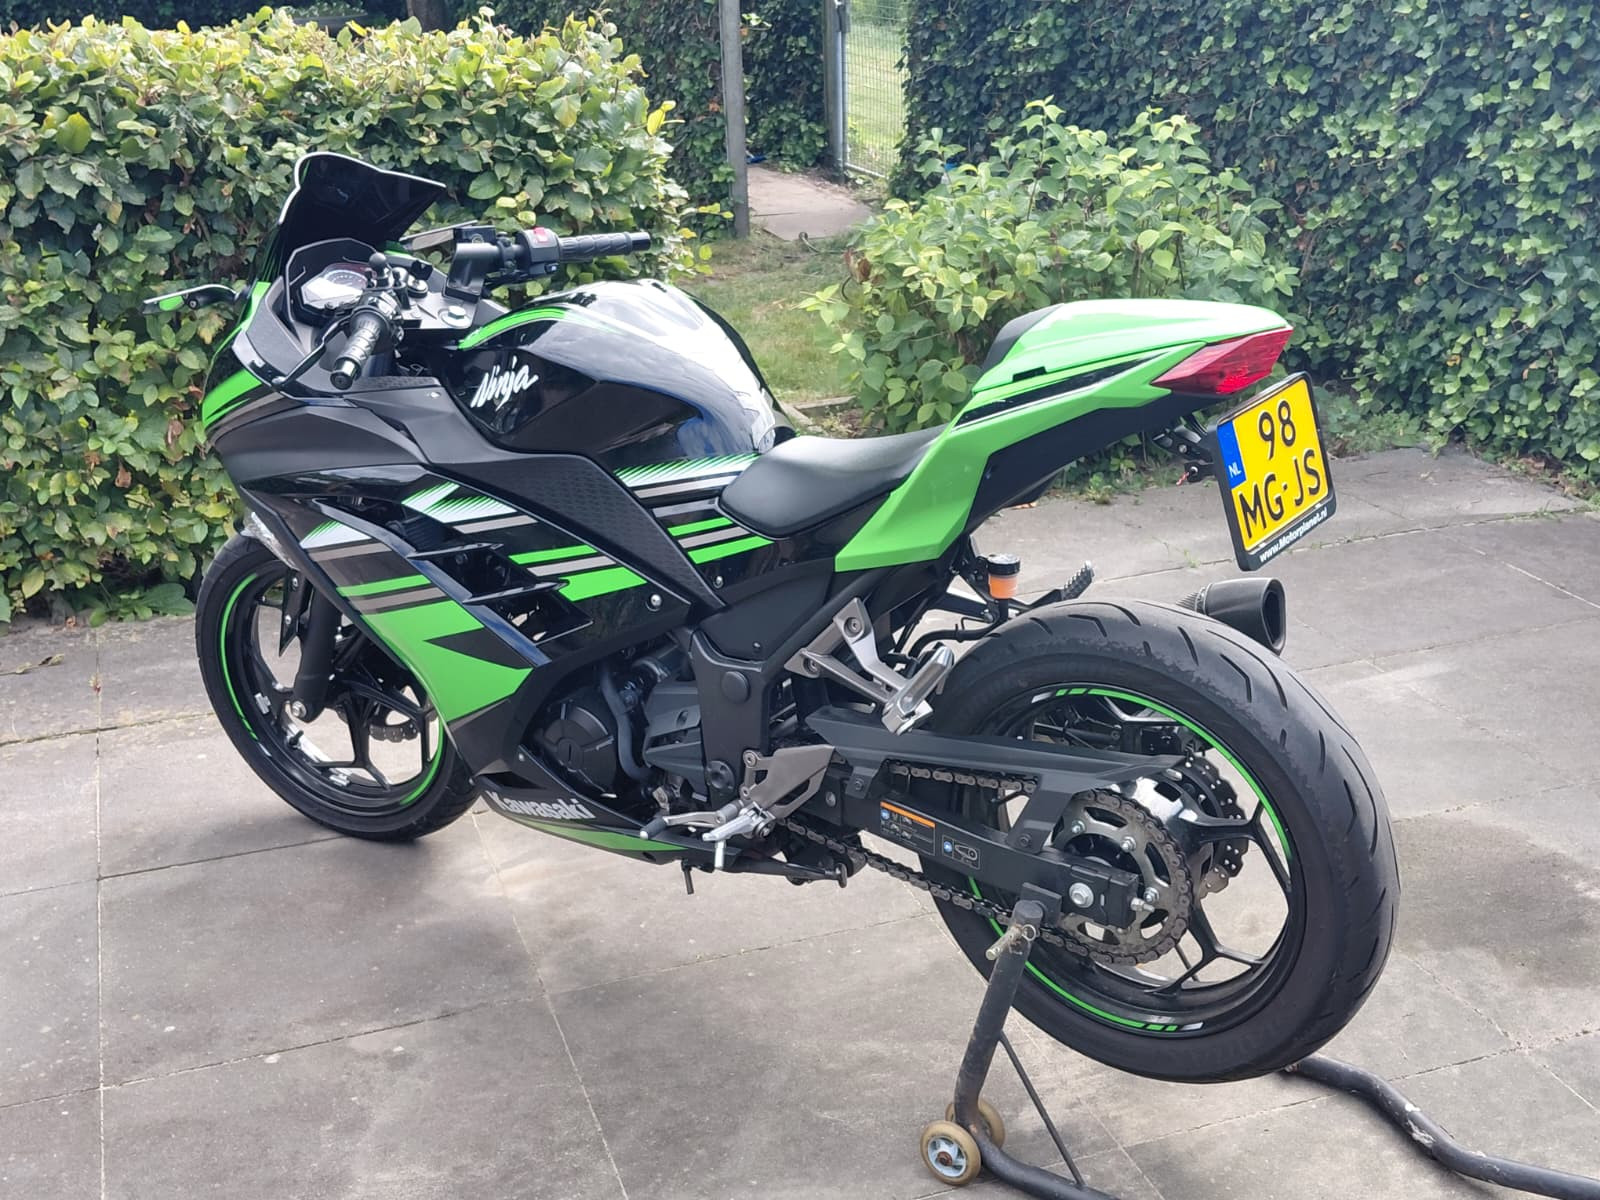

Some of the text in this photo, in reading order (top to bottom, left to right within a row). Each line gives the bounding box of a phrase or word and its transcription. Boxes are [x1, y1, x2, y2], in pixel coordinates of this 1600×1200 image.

[470, 355, 539, 412] Ninja
[1258, 400, 1296, 461] 98
[1228, 462, 1242, 478] NL
[485, 790, 596, 819] Kawasaki
